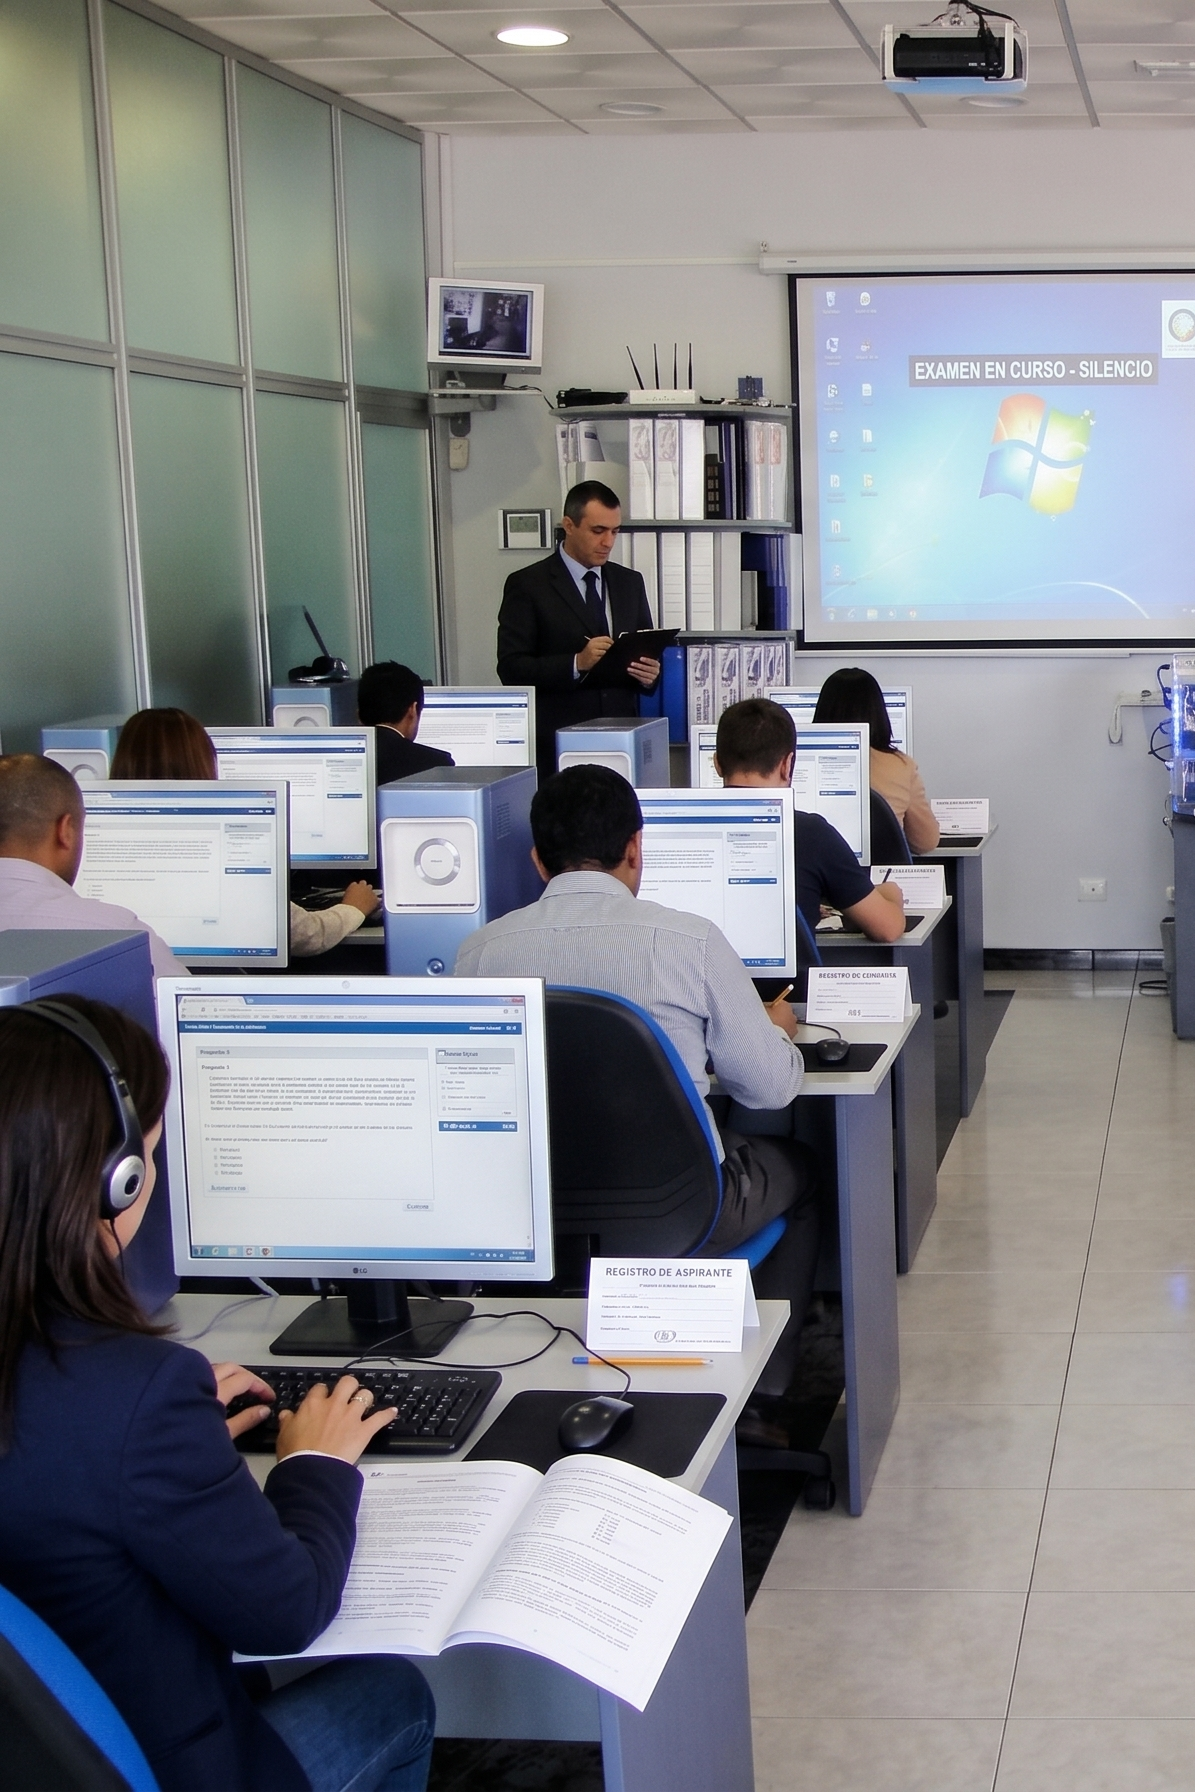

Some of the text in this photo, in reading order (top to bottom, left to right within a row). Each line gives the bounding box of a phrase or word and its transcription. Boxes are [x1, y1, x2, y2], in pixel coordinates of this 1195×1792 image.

[915, 361, 980, 380] EXAMEN
[985, 361, 1006, 379] EN
[1010, 360, 1066, 379] CURSO
[1079, 359, 1153, 378] SILENCIO
[605, 1267, 733, 1278] REGISTRO DE ASPIRANTE
